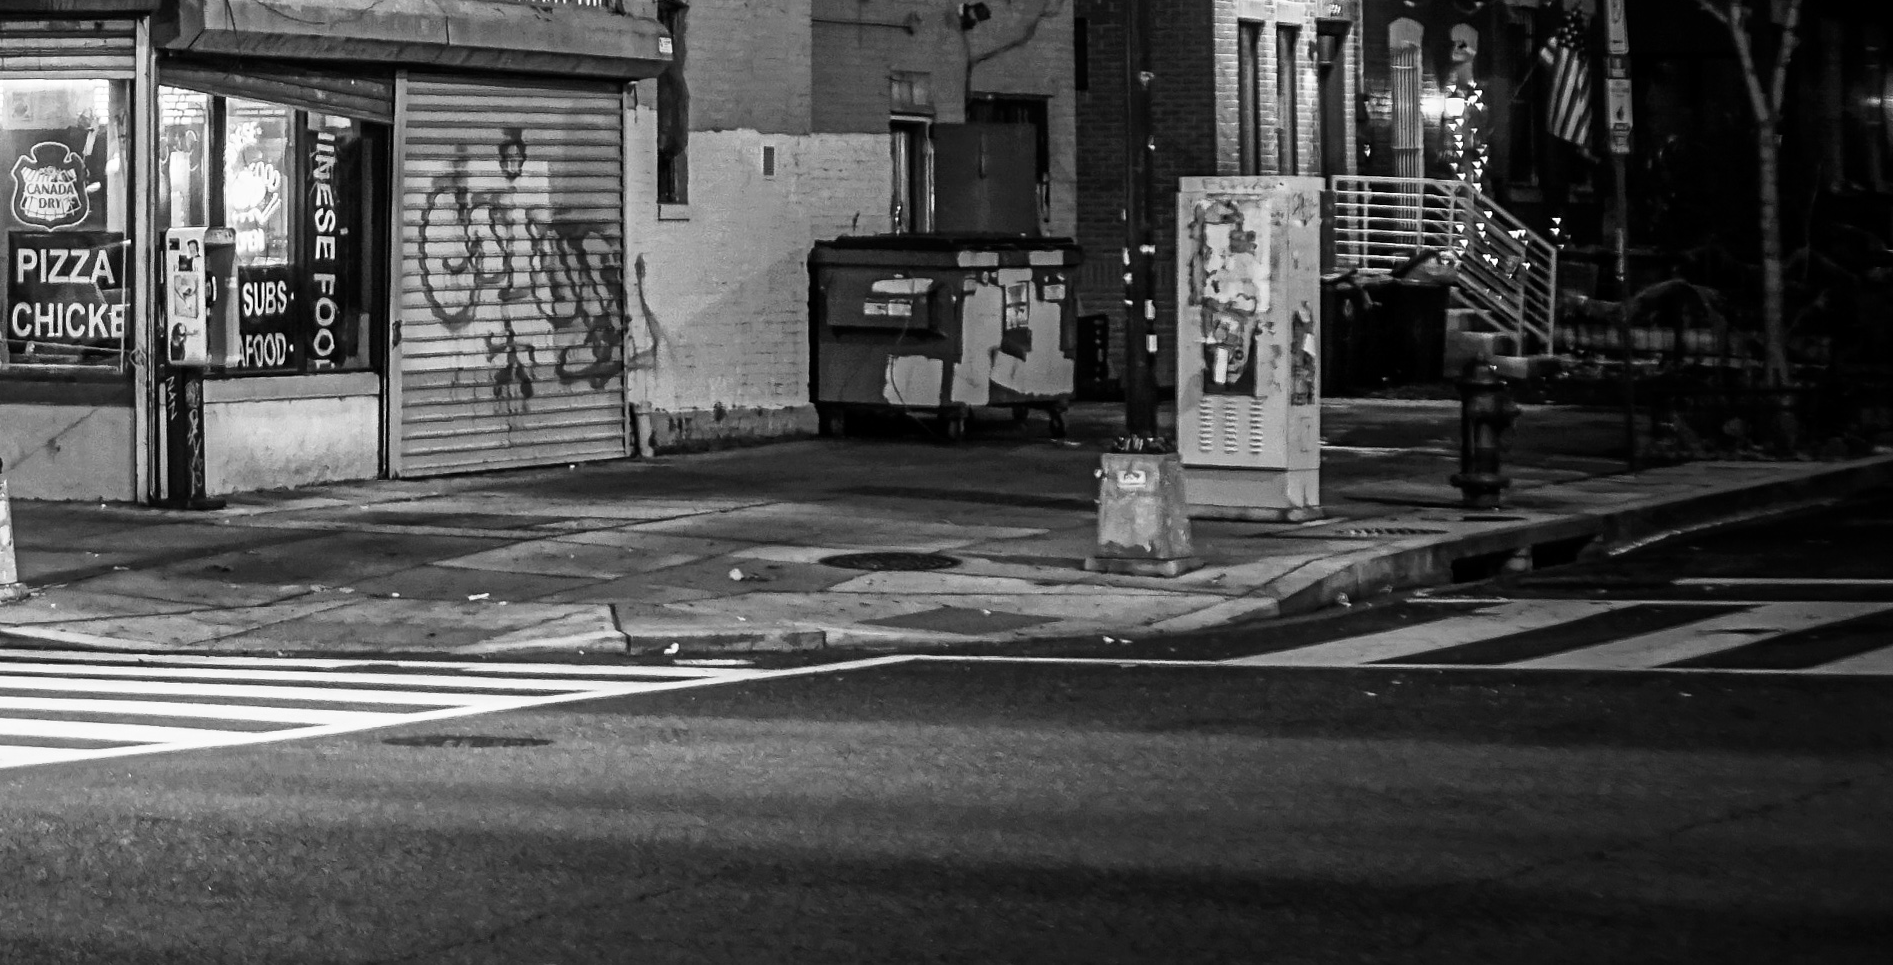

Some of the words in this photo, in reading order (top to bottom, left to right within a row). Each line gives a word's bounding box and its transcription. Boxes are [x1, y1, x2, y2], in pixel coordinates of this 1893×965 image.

[26, 183, 75, 195] CANADA
[38, 197, 61, 209] DRY
[17, 248, 116, 284] PIZZA
[242, 280, 288, 317] SUBS
